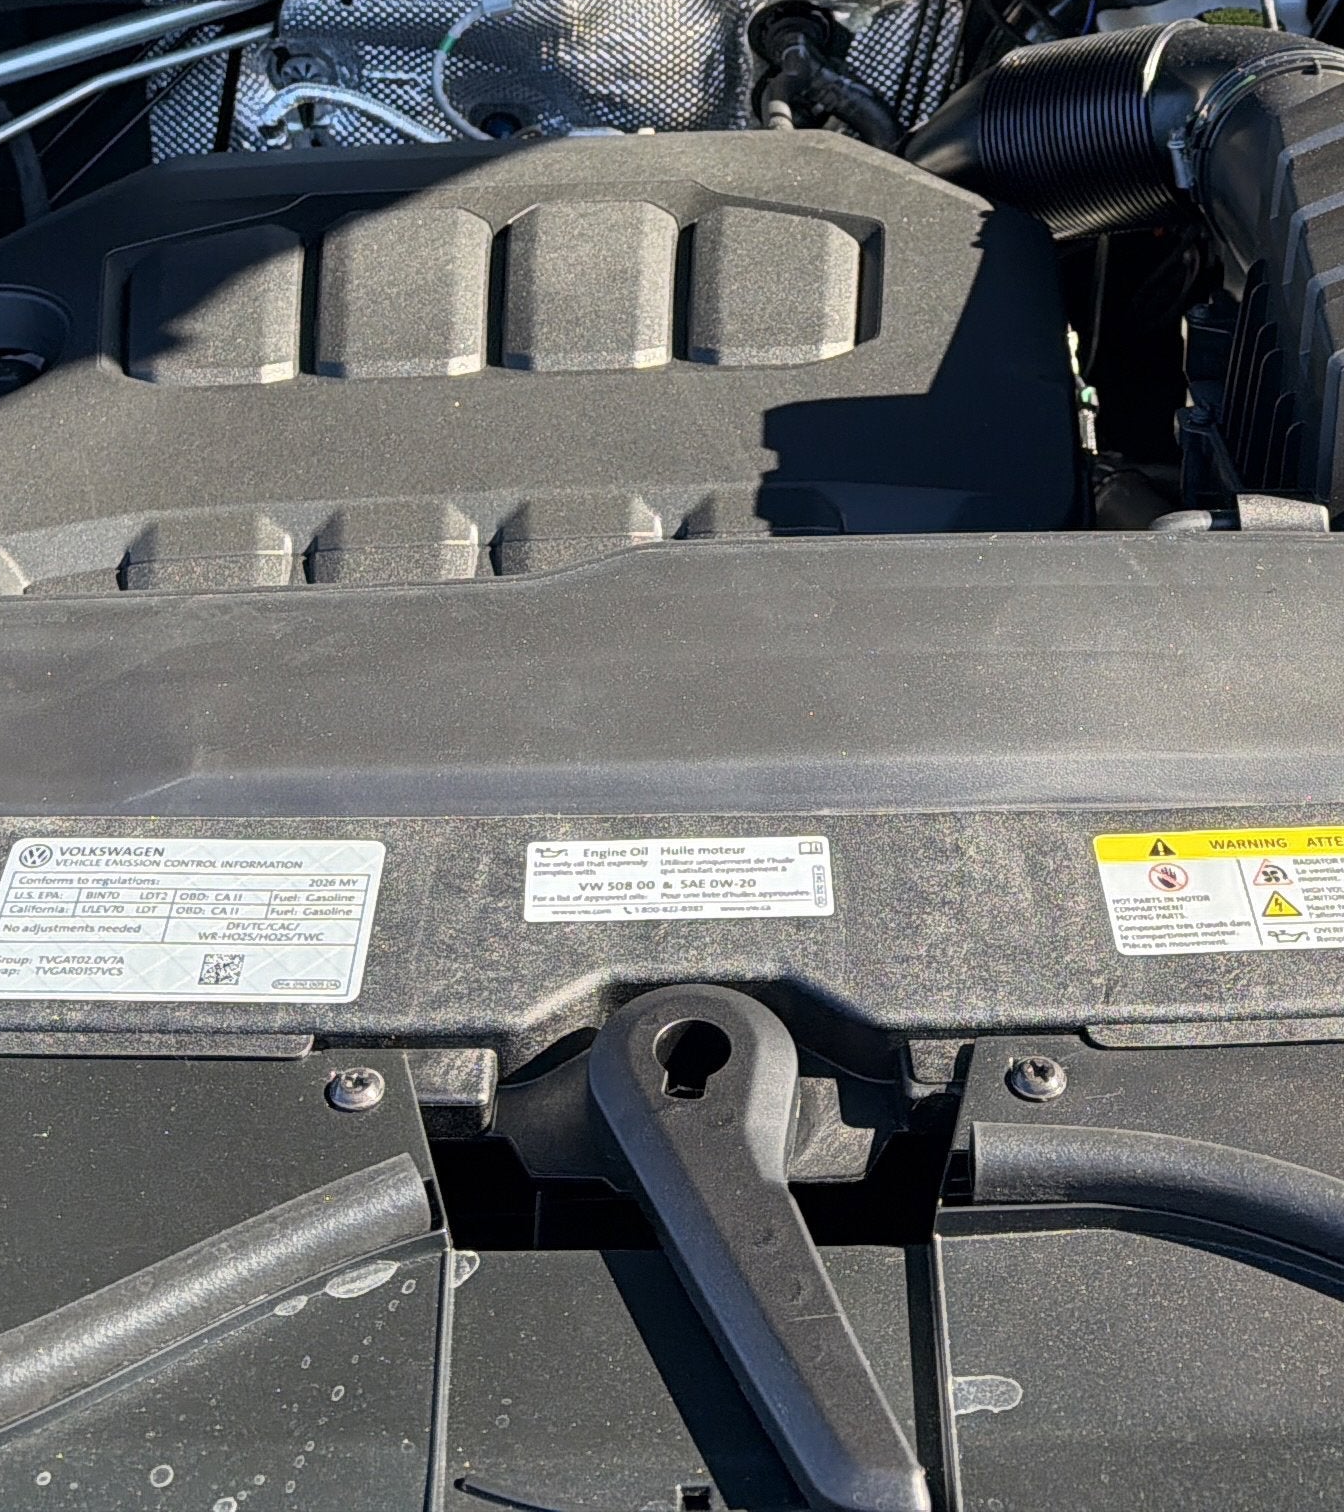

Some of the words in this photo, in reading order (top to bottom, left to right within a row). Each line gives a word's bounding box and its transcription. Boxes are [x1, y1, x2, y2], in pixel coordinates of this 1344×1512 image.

[1208, 837, 1288, 850] WARNING
[59, 846, 166, 857] VOLKSWAGEN
[583, 848, 627, 859] Engine
[629, 847, 649, 857] Oil
[660, 846, 695, 855] Huile
[698, 845, 746, 855] moteur
[55, 858, 102, 868] VEHICLE
[104, 858, 161, 868] EMISSION
[163, 859, 218, 868] CONTROL
[220, 860, 304, 870] INFORMATION
[586, 859, 605, 867] that
[575, 868, 597, 876] with
[19, 876, 74, 885] Conforms
[77, 876, 90, 885] to
[92, 876, 161, 887] regulations:
[309, 878, 337, 888] 2026
[338, 878, 359, 887] MY
[578, 881, 604, 891] VW
[607, 881, 633, 891] 508
[636, 880, 656, 890] 00
[662, 880, 673, 889] &
[680, 879, 706, 889] SAE
[709, 878, 757, 889] 0W-20
[85, 891, 121, 900] BIN70
[139, 892, 169, 902] LDT2
[179, 892, 209, 901] OBD:
[215, 892, 232, 901] CA
[273, 893, 300, 902] Fuel:
[306, 893, 356, 903] Gasoline
[9, 904, 69, 914] California:
[135, 905, 158, 914] LDT
[175, 906, 206, 915] OBD:
[211, 906, 228, 915] CA
[269, 907, 298, 916] Fuel:
[303, 907, 353, 917] Gasoline
[2, 924, 19, 934] No
[21, 924, 96, 936] adjustments
[97, 925, 143, 934] needed
